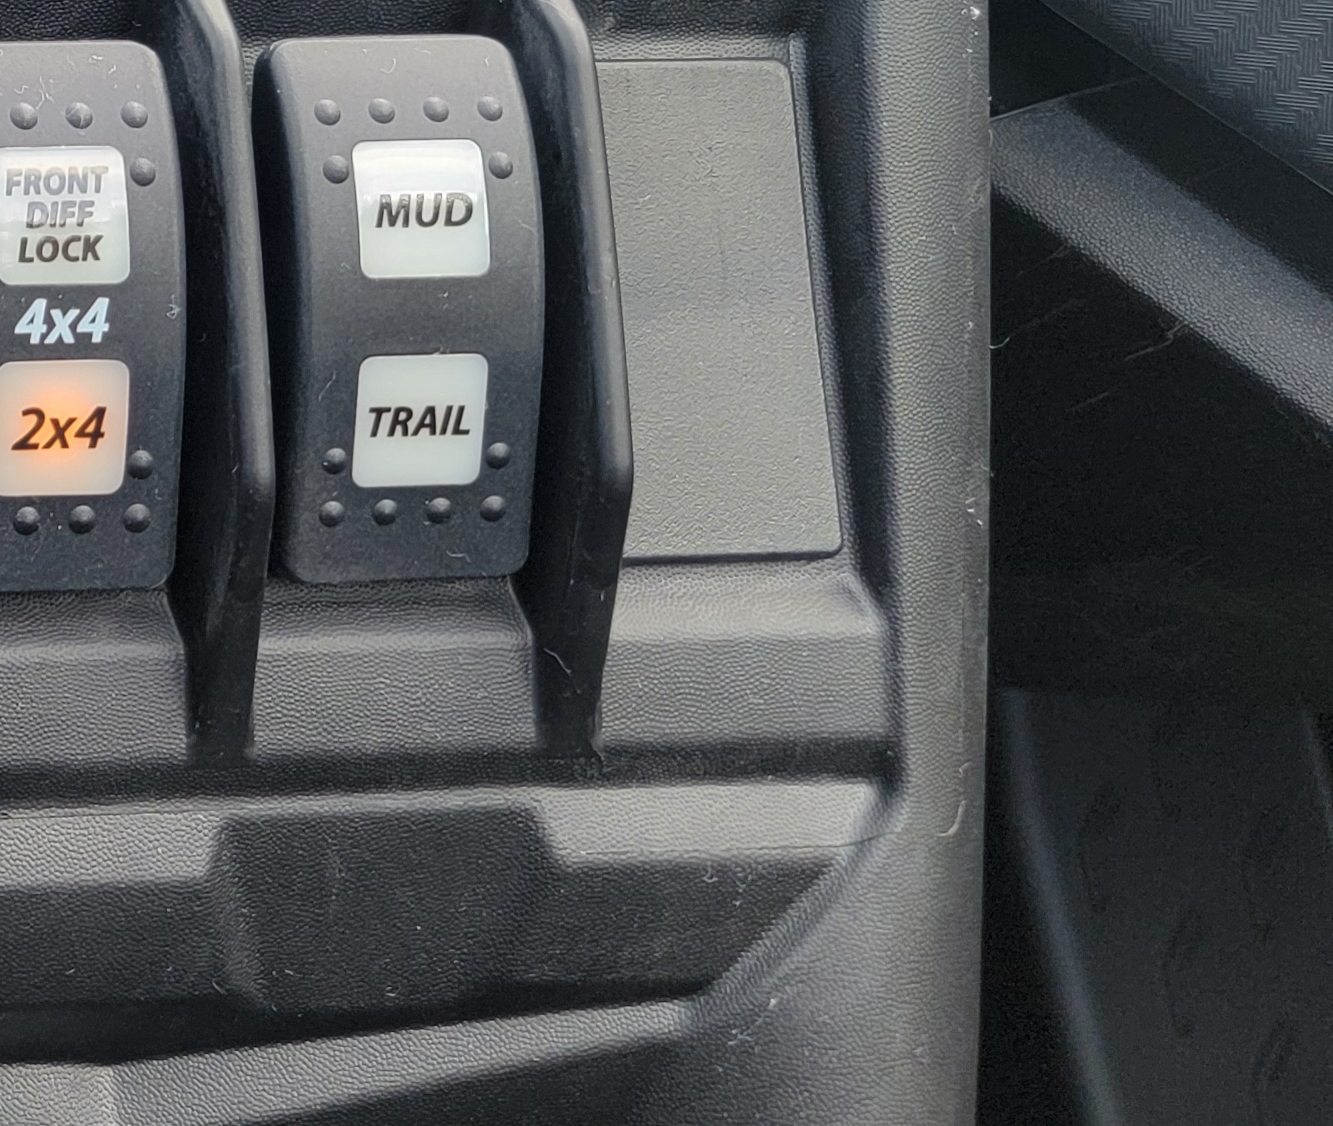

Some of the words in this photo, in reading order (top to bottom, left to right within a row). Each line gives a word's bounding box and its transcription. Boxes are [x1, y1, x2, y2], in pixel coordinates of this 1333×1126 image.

[4, 165, 109, 198] FRONT
[24, 199, 96, 230] DIFF
[374, 192, 474, 229] MUD
[17, 234, 105, 264] LOCK
[14, 296, 110, 345] 4x4
[10, 406, 108, 451] 2x4
[366, 404, 472, 438] TRAIL
